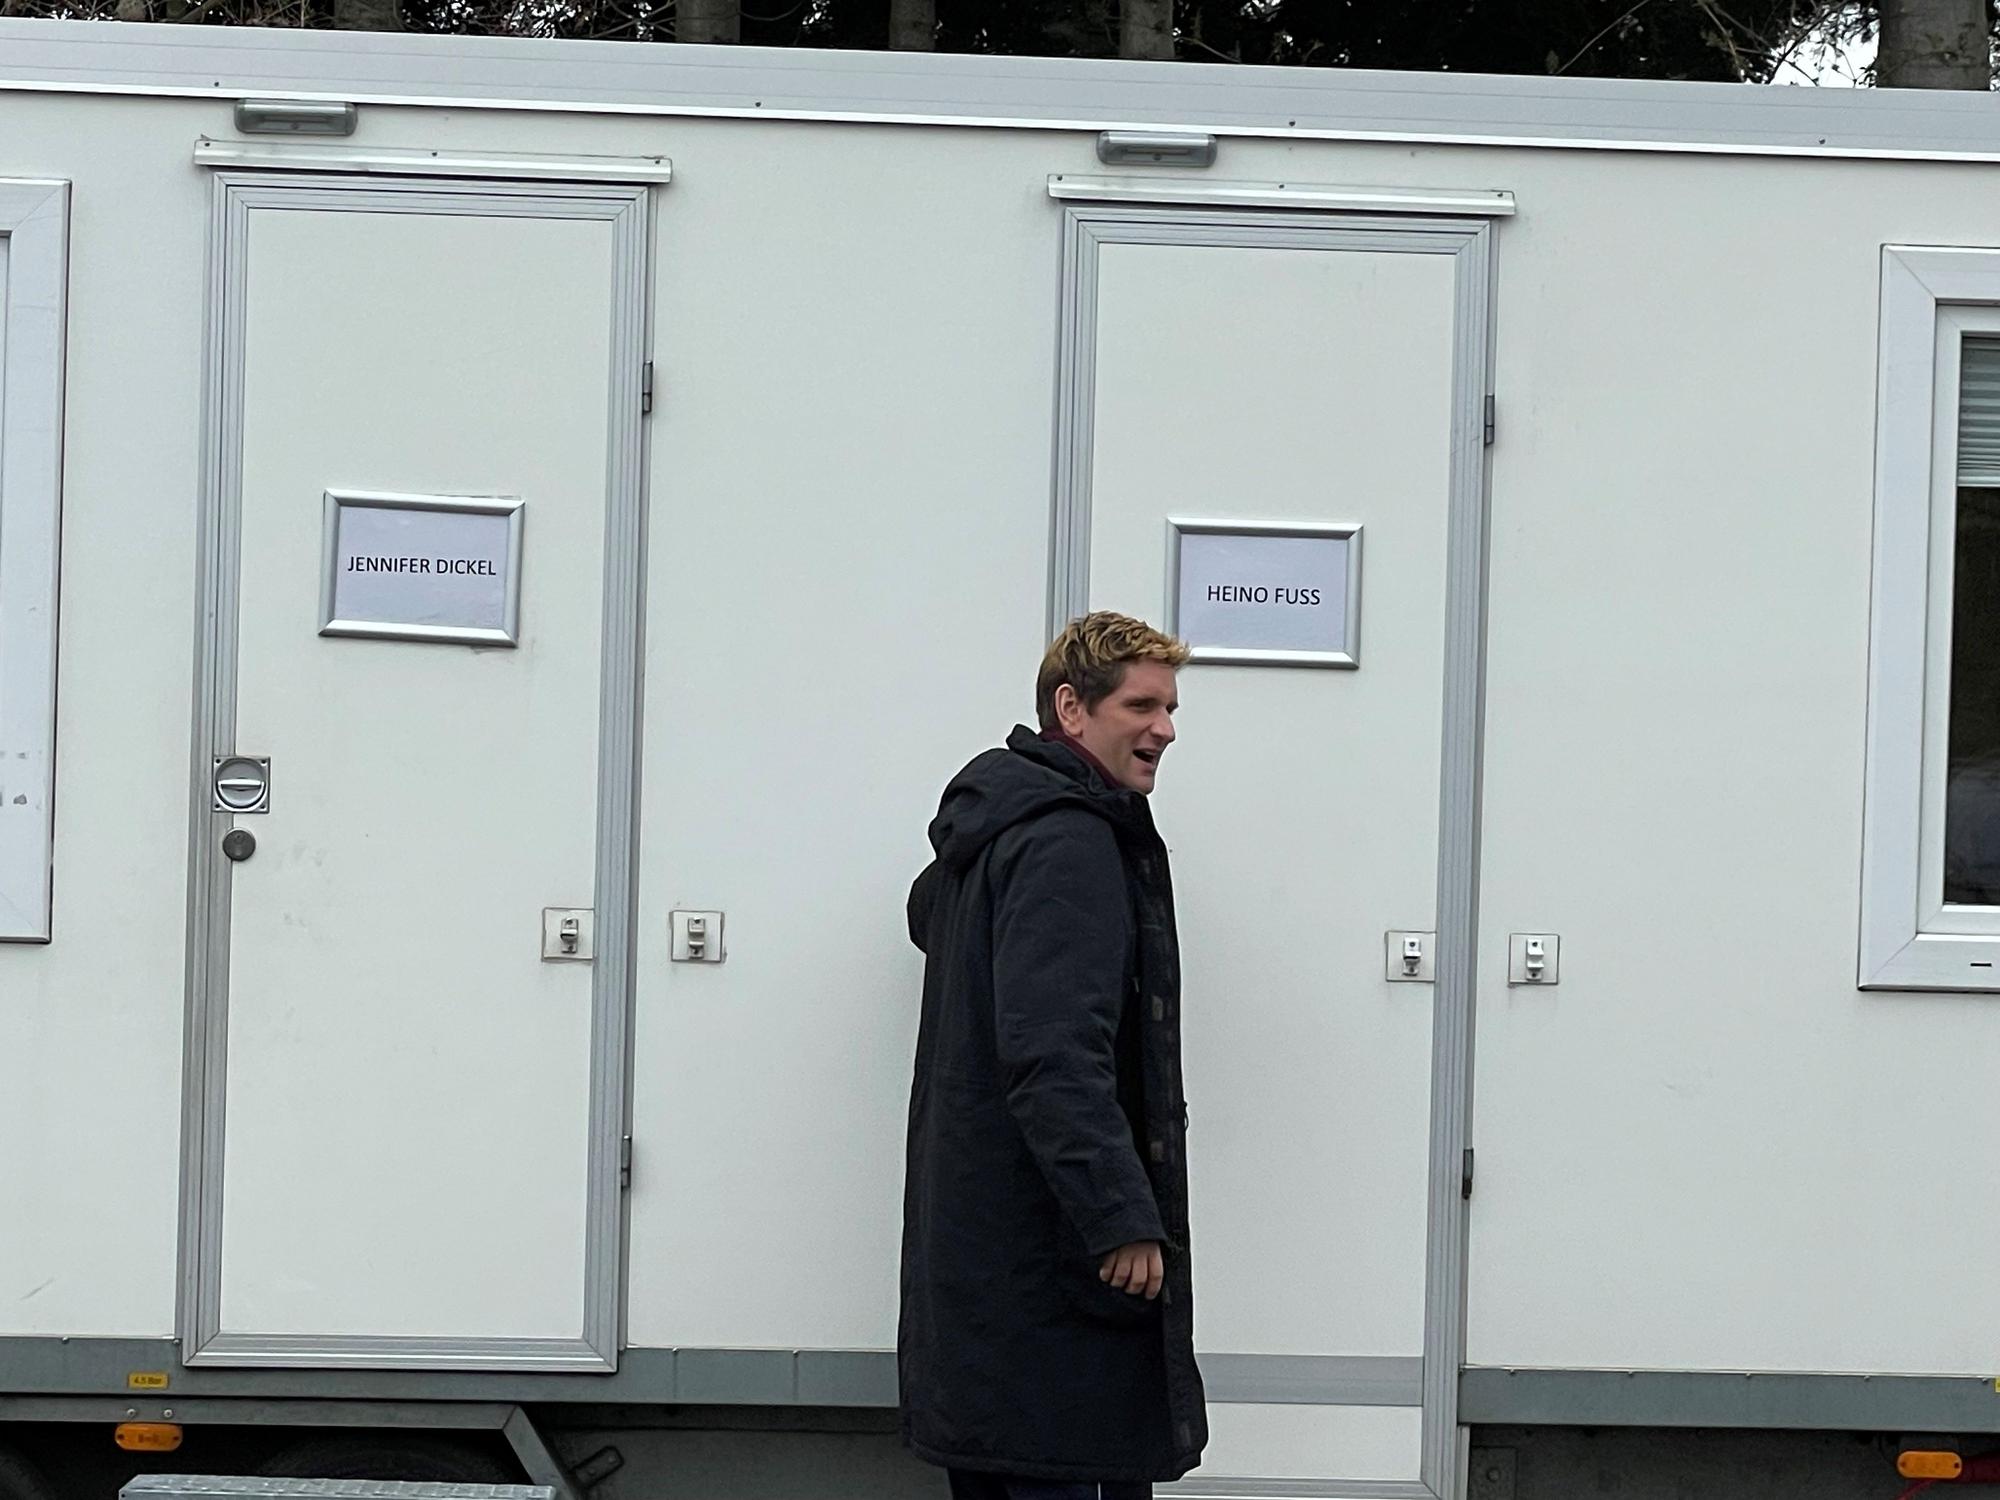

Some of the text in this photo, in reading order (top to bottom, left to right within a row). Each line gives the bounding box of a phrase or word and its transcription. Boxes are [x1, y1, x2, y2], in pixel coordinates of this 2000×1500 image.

[347, 556, 497, 576] JENNIFER DICKEL
[1207, 585, 1321, 606] HEINO FUSS
